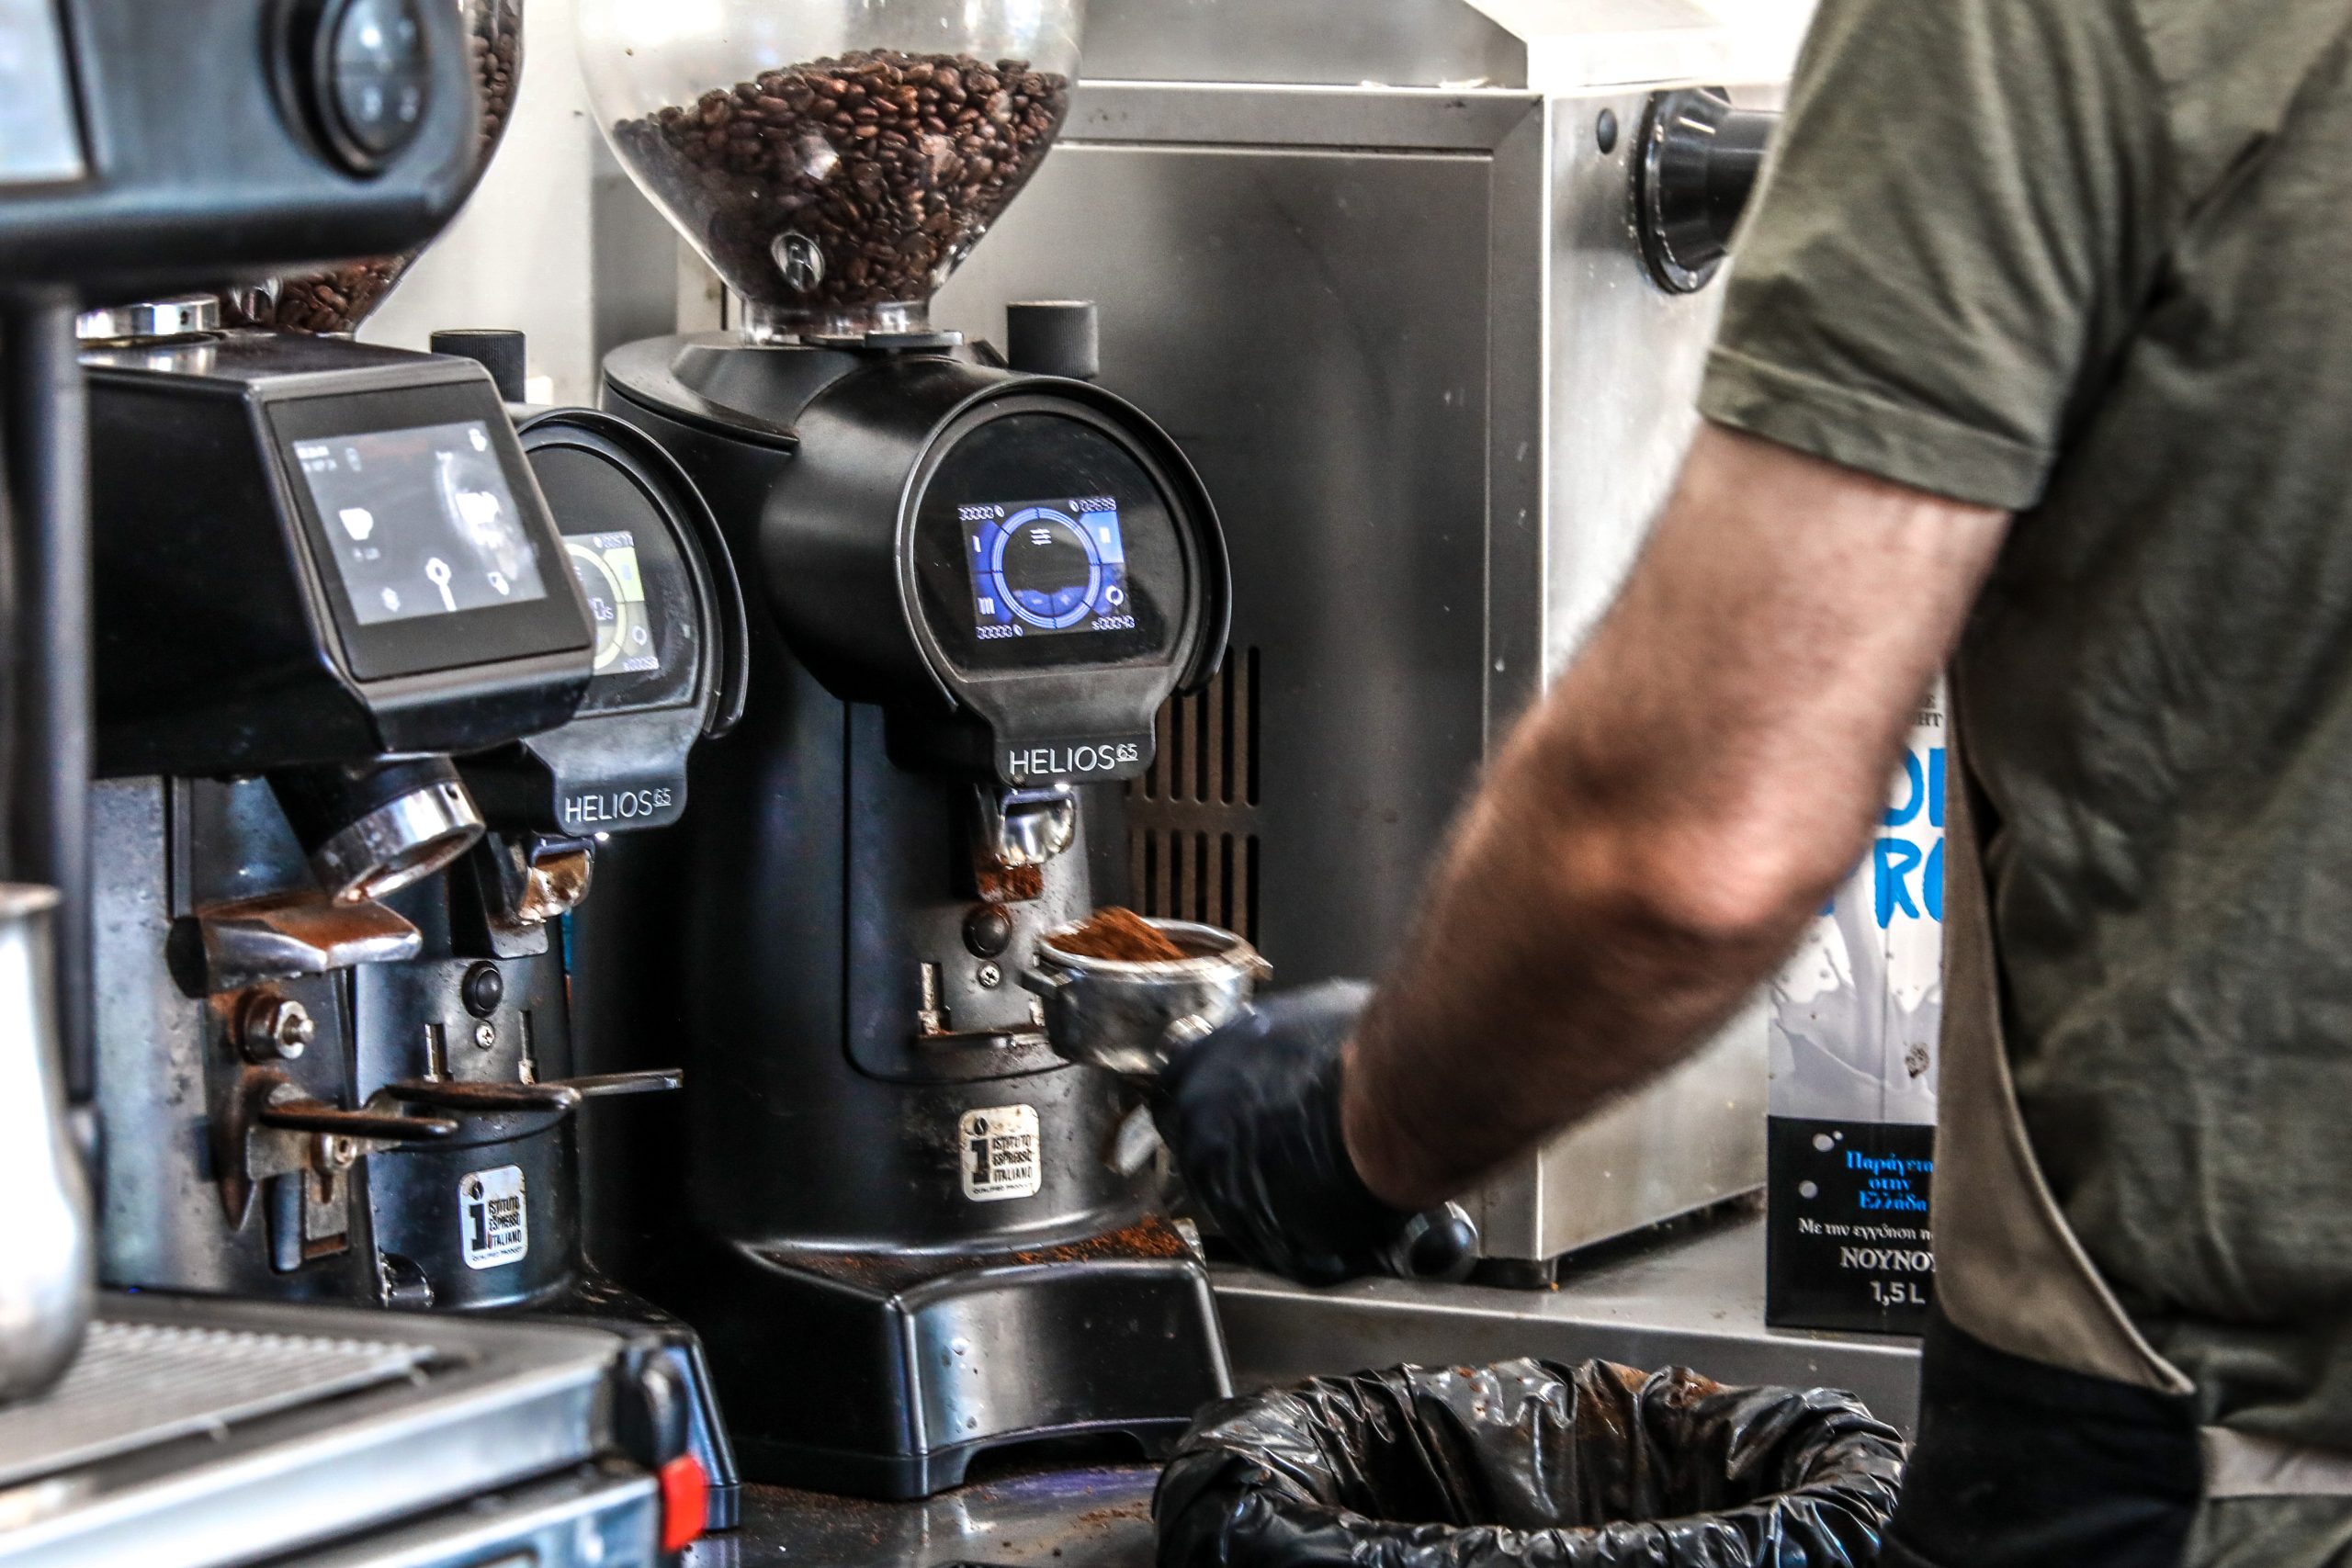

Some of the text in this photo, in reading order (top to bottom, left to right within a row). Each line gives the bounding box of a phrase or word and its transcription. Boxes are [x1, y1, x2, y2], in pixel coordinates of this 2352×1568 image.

[992, 1134, 1031, 1149] ISTITUTO
[992, 1151, 1033, 1166] ESPRESSO
[993, 1167, 1033, 1182] ITALIANO
[489, 1196, 519, 1214] ISTITUTO
[489, 1213, 521, 1231] ESPRESSO
[1798, 1217, 1822, 1235] Με
[488, 1230, 522, 1248] ITALIANO
[1870, 1280, 1926, 1306] 1,5 L
